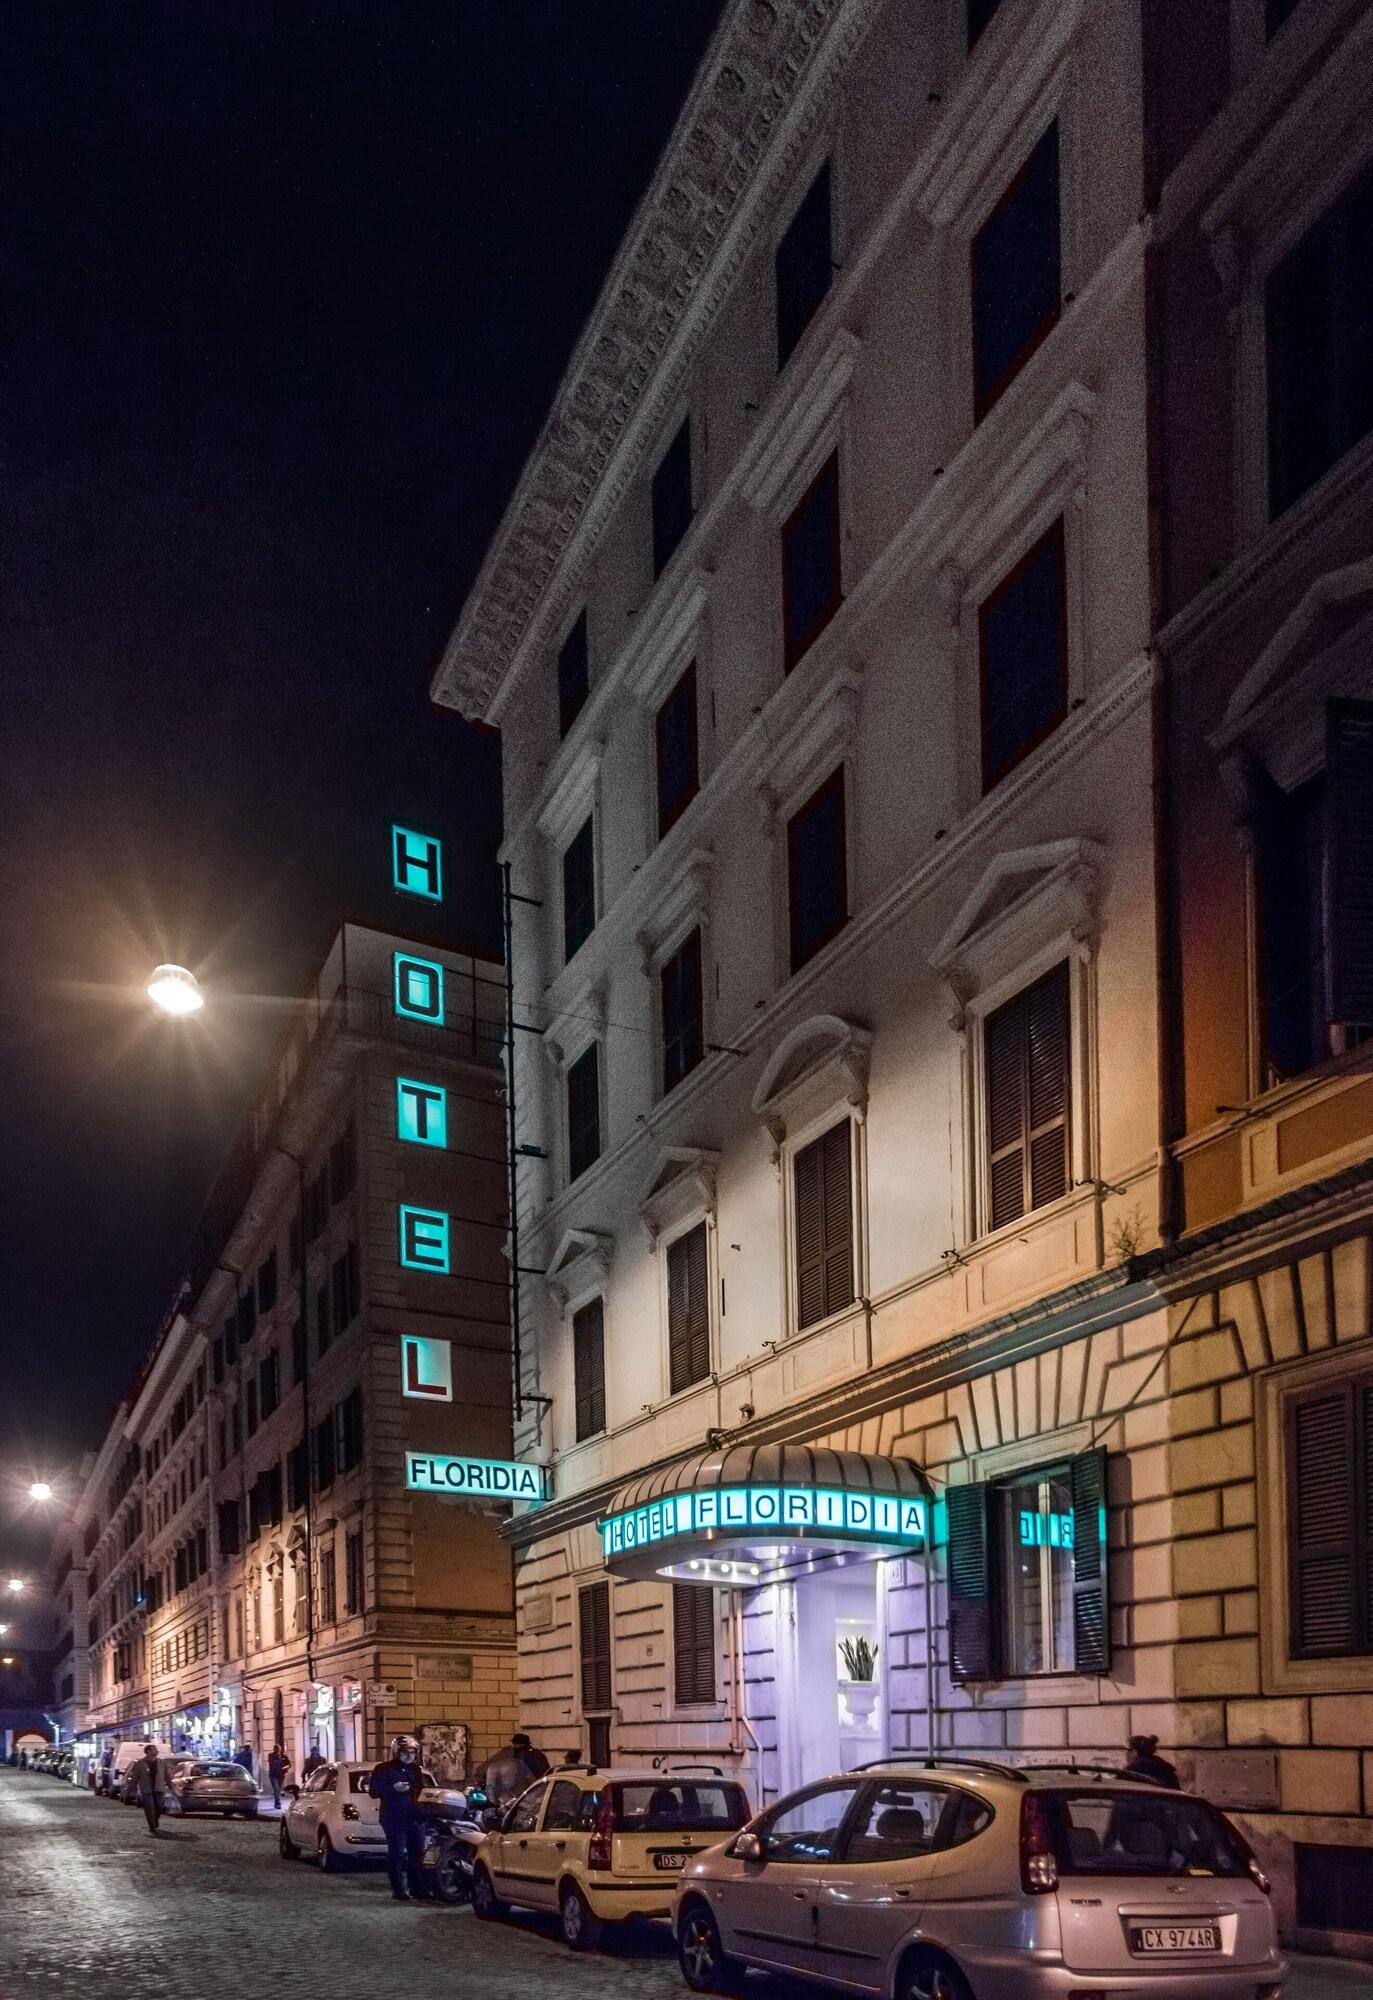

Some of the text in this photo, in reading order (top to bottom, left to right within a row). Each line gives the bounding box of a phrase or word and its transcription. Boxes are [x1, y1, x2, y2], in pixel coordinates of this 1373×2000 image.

[396, 831, 447, 1396] HOTEL
[411, 1458, 537, 1494] FLORIDIA
[614, 1494, 922, 1548] HOTEL FLORIDIA
[1145, 1930, 1212, 1948] CX 974AR
